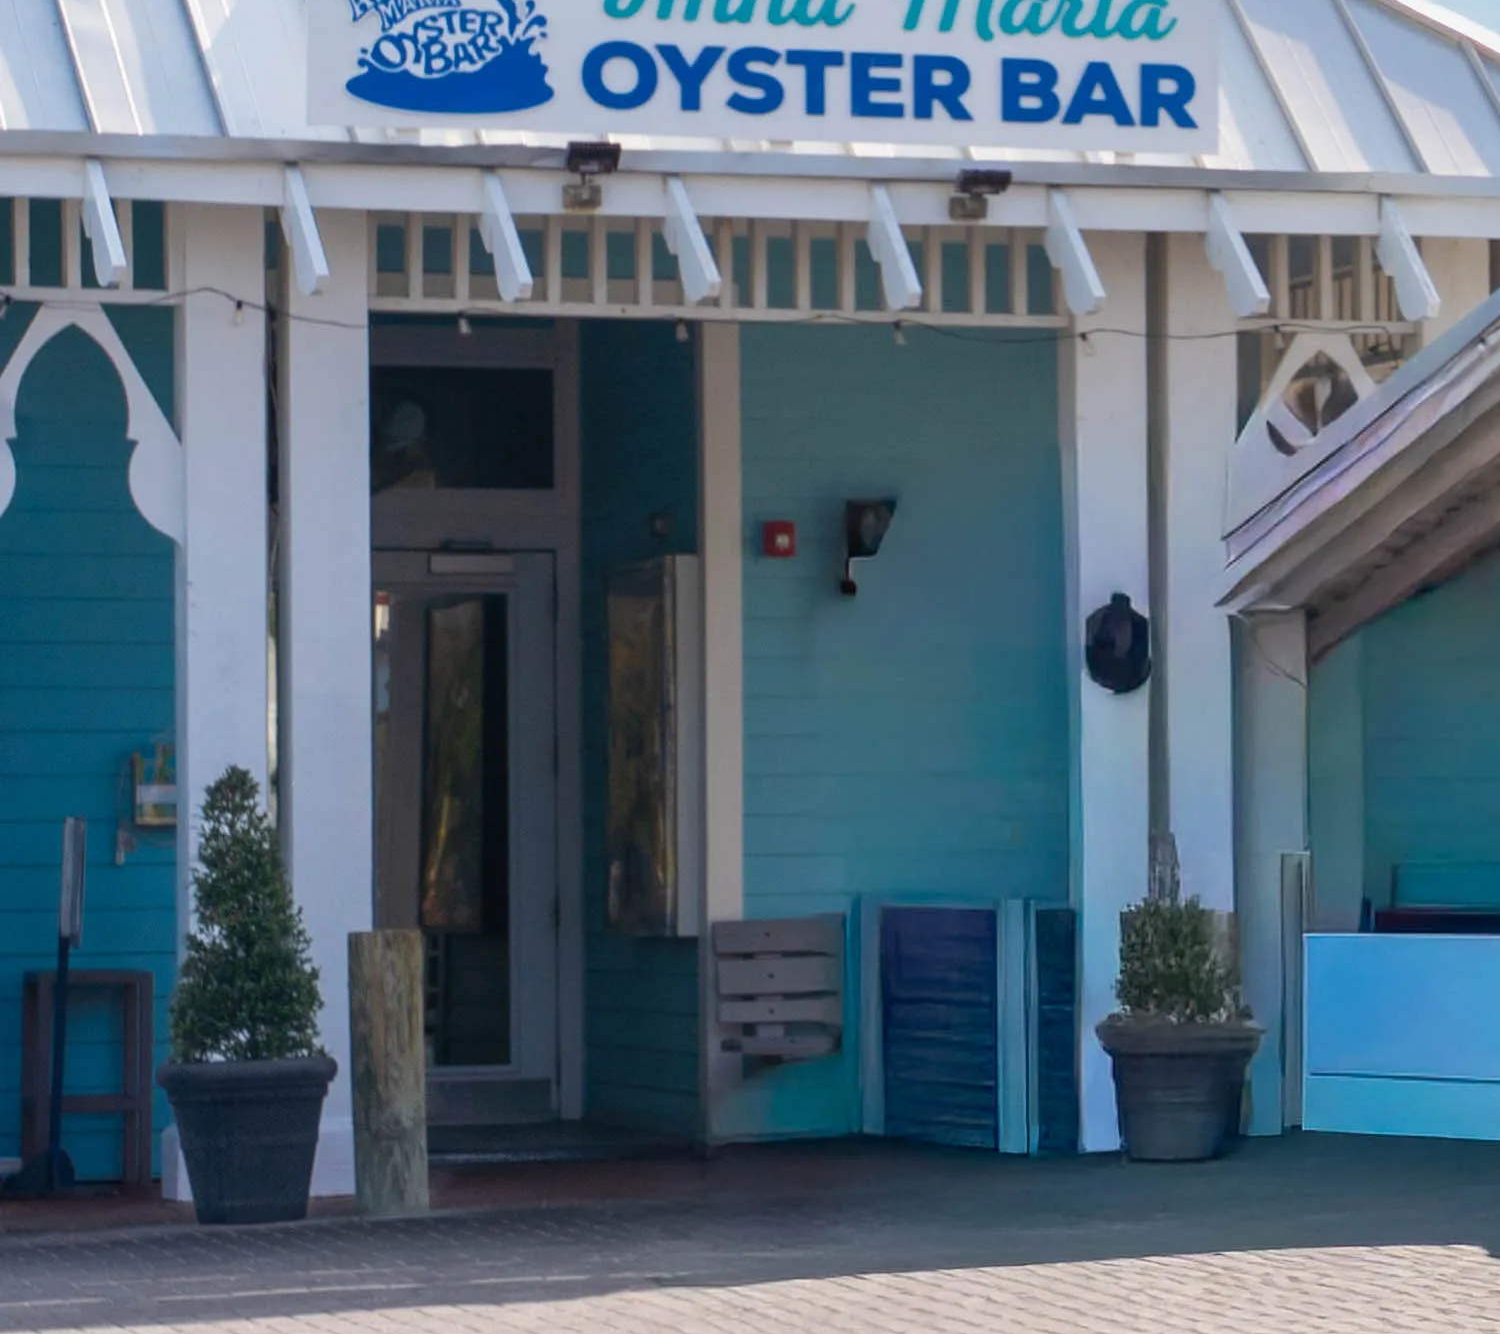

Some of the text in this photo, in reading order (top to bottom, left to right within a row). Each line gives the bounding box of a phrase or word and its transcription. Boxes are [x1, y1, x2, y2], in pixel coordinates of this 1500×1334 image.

[371, 9, 504, 69] OYSTER
[421, 33, 502, 75] BAR
[582, 39, 1197, 130] OYSTER BAR
